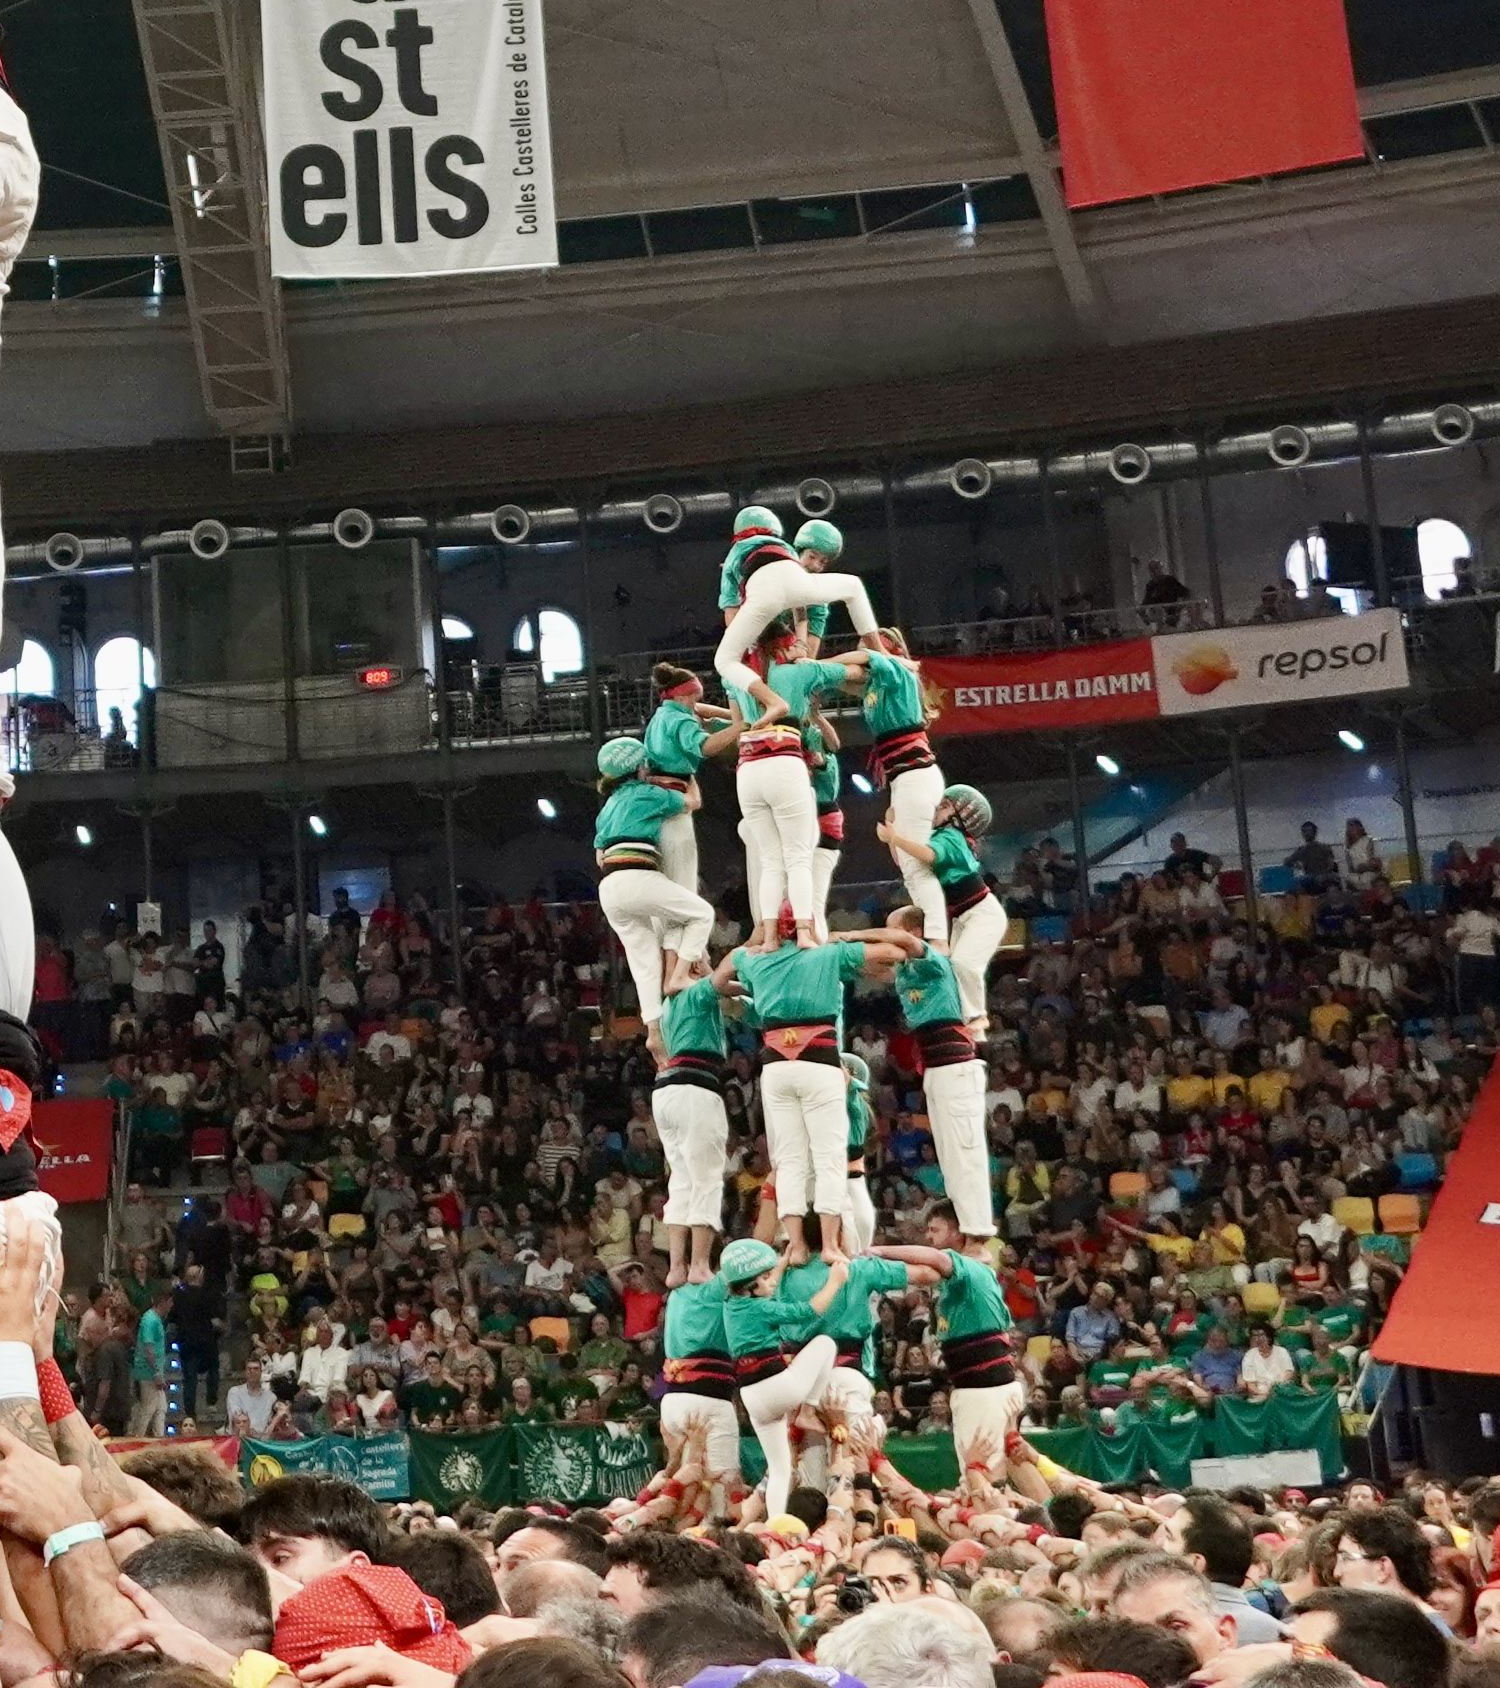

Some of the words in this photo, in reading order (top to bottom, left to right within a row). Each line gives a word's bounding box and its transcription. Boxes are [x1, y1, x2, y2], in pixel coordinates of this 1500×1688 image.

[513, 49, 528, 73] de
[510, 77, 530, 179] Castelleres
[516, 182, 539, 235] Colles
[1257, 631, 1389, 681] repsol
[954, 676, 1070, 708] ESTRELLA
[1073, 670, 1152, 702] DAMM
